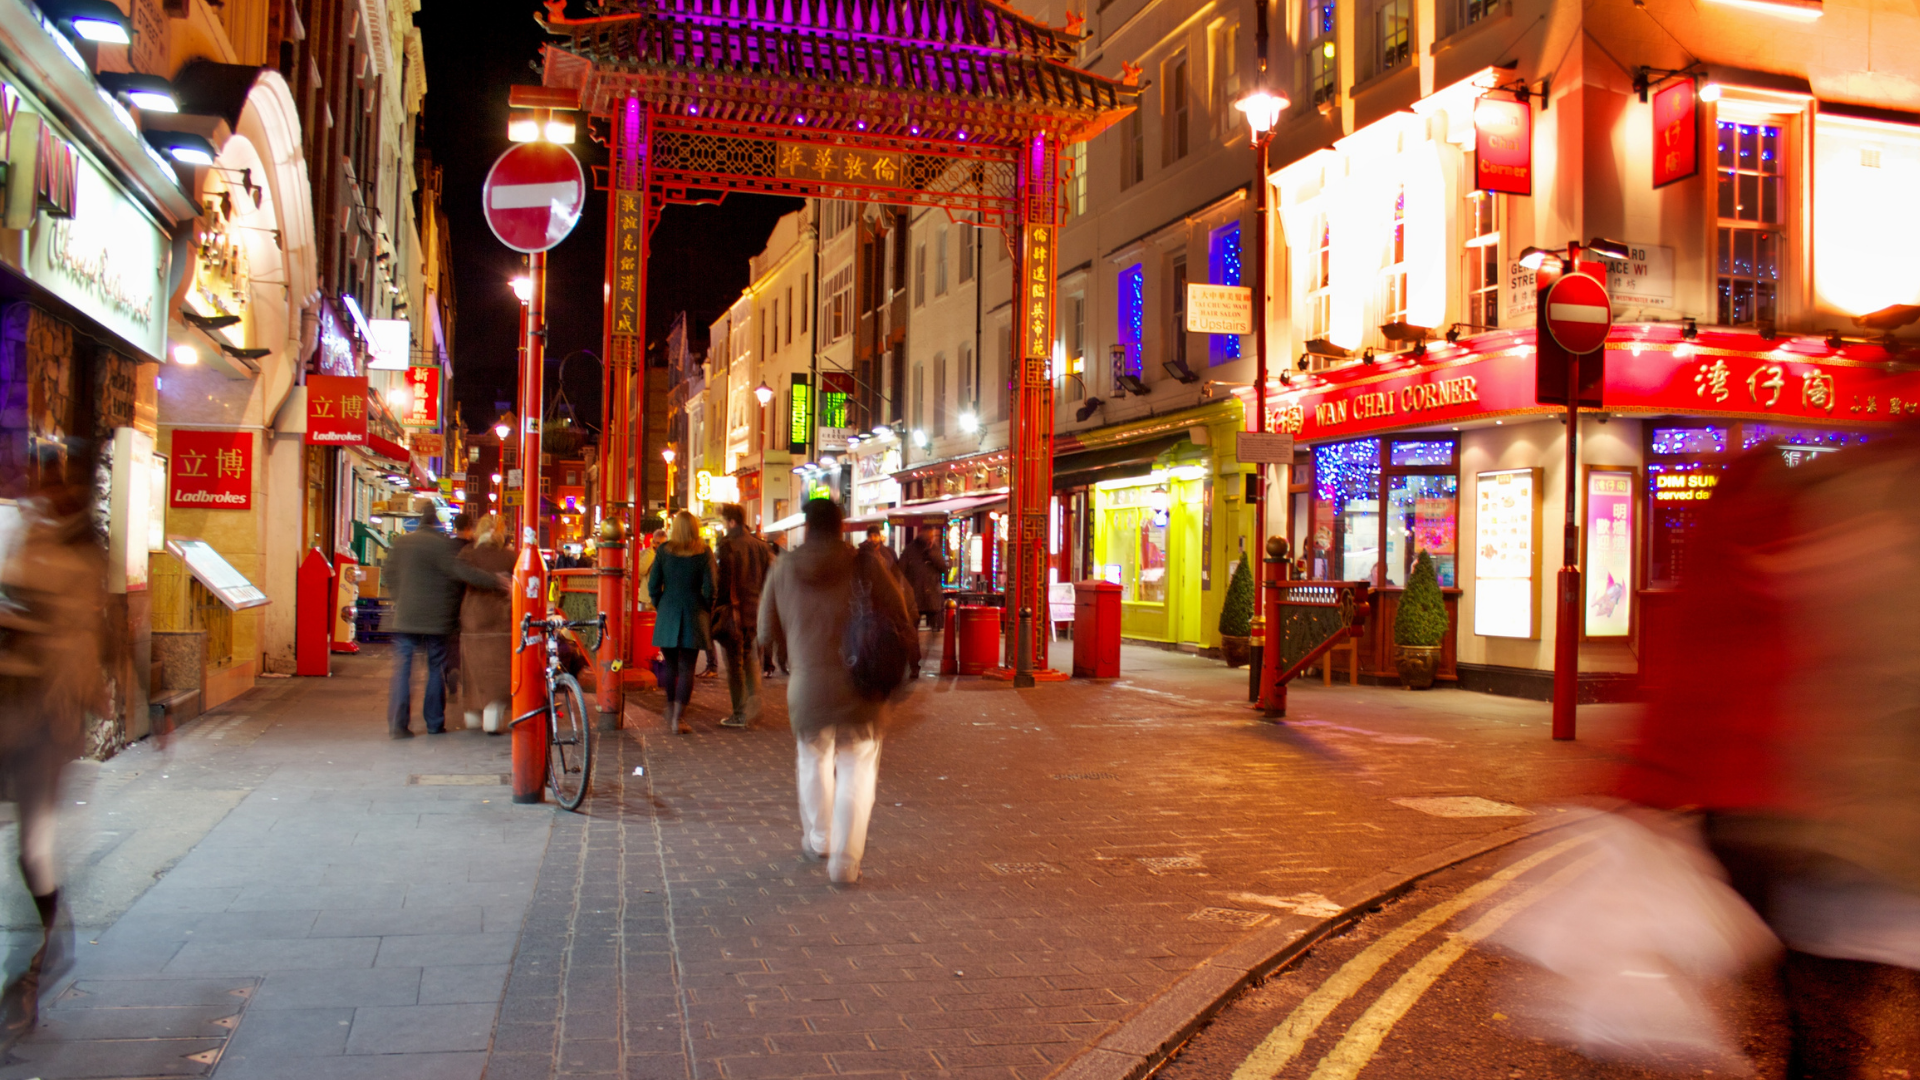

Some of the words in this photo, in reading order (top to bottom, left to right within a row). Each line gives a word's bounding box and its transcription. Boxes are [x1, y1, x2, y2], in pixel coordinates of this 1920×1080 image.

[1480, 159, 1527, 177] Corner
[1634, 263, 1648, 277] W1
[1511, 273, 1538, 289] STRE
[1199, 318, 1246, 331] Upstairs
[310, 395, 363, 419] 立博
[1315, 398, 1348, 427] WAN
[1353, 390, 1395, 420] CHAI
[1401, 375, 1478, 413] CORNER
[313, 431, 362, 441] Ladbrokes
[177, 447, 245, 480] 立博
[1657, 475, 1686, 488] DIM
[175, 488, 246, 504] Ladbrokes
[1657, 489, 1694, 500] served
